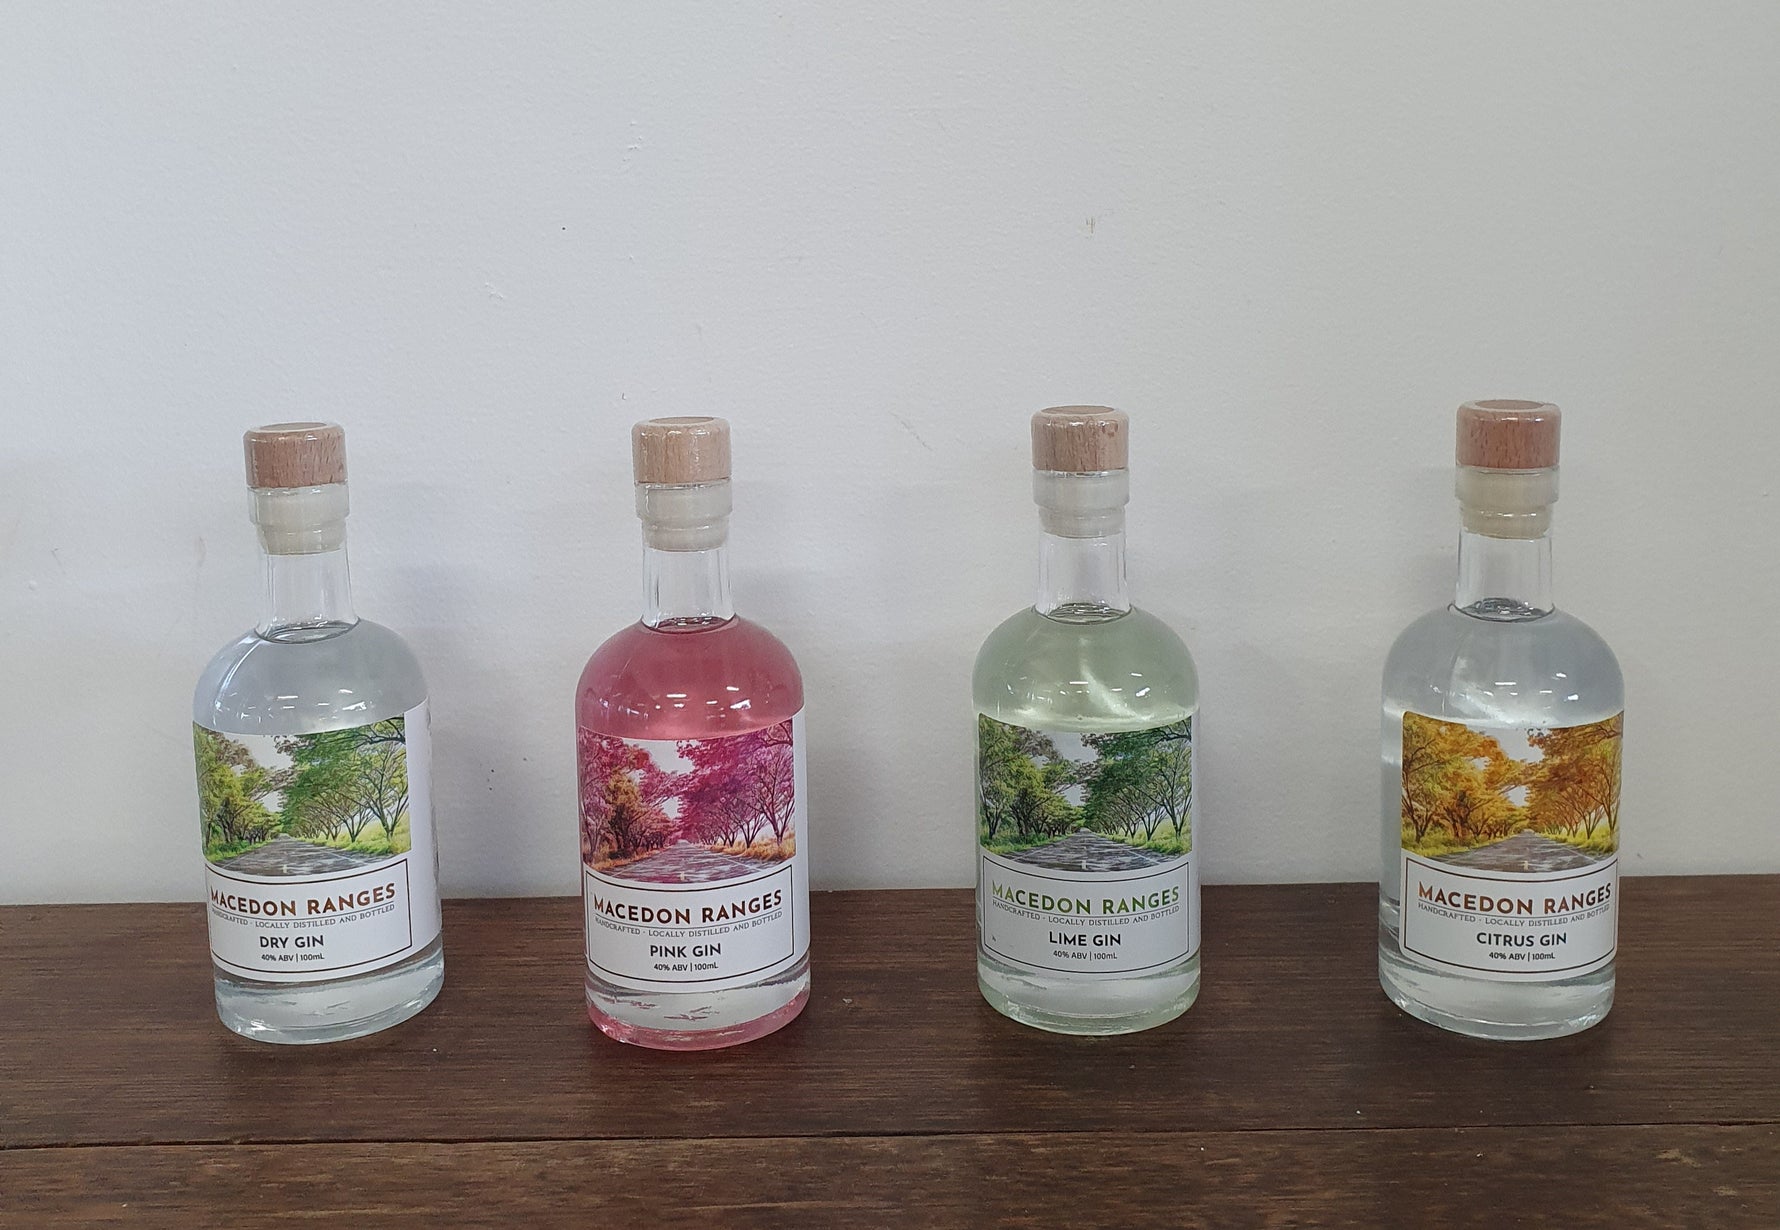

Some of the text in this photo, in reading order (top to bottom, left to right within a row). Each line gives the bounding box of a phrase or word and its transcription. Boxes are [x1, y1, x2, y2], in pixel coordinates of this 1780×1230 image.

[210, 883, 395, 916] MACEDON RANGES
[593, 889, 782, 924] MACEDON RANGES
[992, 880, 1179, 914] MACEDON RANGES
[1418, 881, 1611, 915] MACEDON RANGES
[294, 919, 336, 928] DISTILLED
[339, 911, 357, 923] AND
[360, 904, 395, 919] BOTTLED
[689, 927, 729, 937] DISTILLED
[733, 921, 749, 931] AND
[752, 911, 782, 928] BOTTLED
[993, 901, 1179, 926] HANDCRAFTED LOCALLY DISTILLED AND BOTTLED
[1418, 902, 1476, 923] HANDCRAFTED
[1486, 917, 1524, 927] LOCALLY
[1528, 917, 1568, 927] DISTILLED
[1570, 914, 1585, 923] AND
[259, 935, 324, 948] DRY GIN
[650, 943, 721, 958] PINK GIN
[1050, 931, 1121, 946] LIME GIN
[1477, 932, 1567, 947] CITRUS GIN
[279, 954, 294, 962] ABV
[300, 953, 325, 961] 100mL
[1053, 950, 1069, 958] 40%
[672, 963, 688, 971] ABV
[694, 962, 718, 970] 100mL
